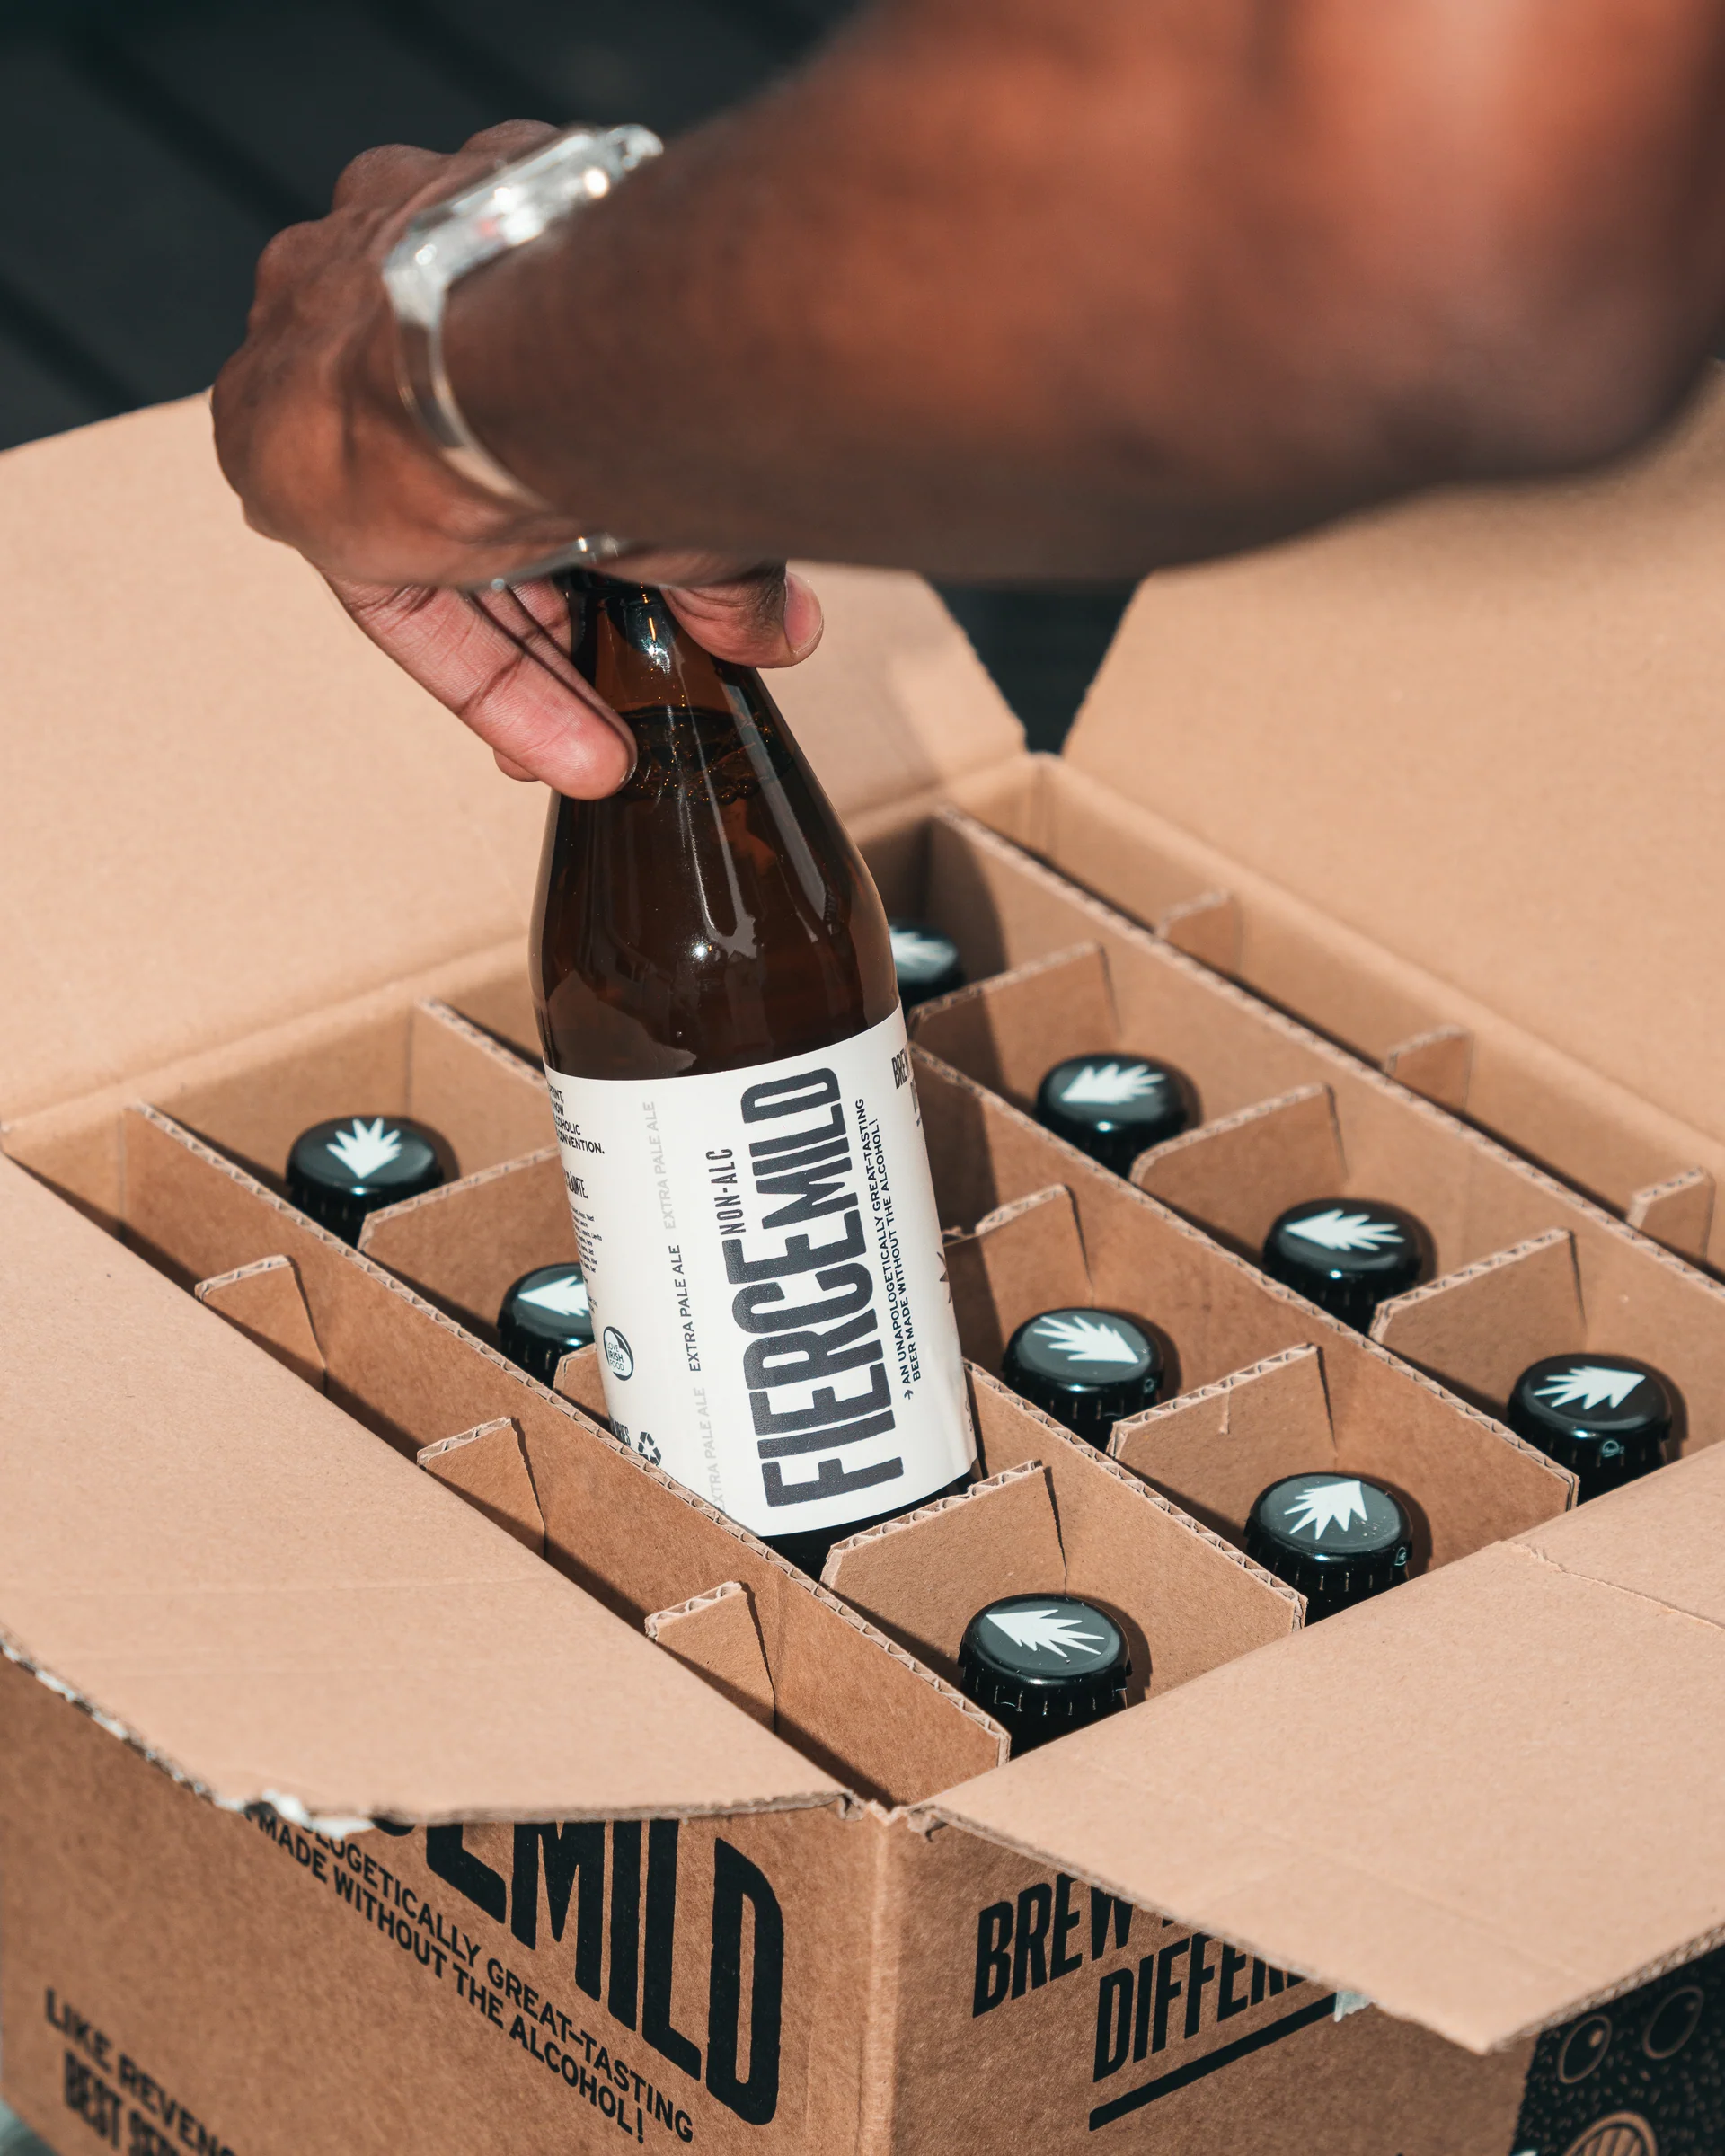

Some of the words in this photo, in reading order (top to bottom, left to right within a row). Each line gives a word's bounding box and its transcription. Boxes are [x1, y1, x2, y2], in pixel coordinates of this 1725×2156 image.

[891, 1047, 910, 1089] BRE
[642, 1101, 659, 1132] ALE
[649, 1135, 666, 1175] PALE
[855, 1099, 881, 1211] GREAT-TASTING
[869, 1118, 889, 1191] ALCOHOL!
[657, 1179, 677, 1229] EXTRA
[706, 1149, 746, 1235] NON-ALC
[883, 1196, 895, 1226] THE
[668, 1245, 684, 1275] ALE
[889, 1230, 907, 1295] WITHOUT
[674, 1279, 692, 1317] PALE
[722, 1067, 904, 1508] FIERCEMILD
[874, 1216, 906, 1362] UNAPOLOGETICALLY
[900, 1297, 915, 1340] MADE
[606, 1341, 619, 1353] LOVE
[608, 1350, 624, 1363] IRISH
[609, 1359, 624, 1372] FOOD
[682, 1321, 701, 1371] EXTRA
[907, 1341, 921, 1382] BEER
[900, 1364, 912, 1384] AN
[693, 1387, 710, 1417] ALE
[700, 1421, 717, 1459] PALE
[258, 1813, 327, 1884] MADE
[333, 1864, 447, 1978] WITHOUT
[453, 1962, 504, 2029] THE
[509, 2014, 644, 2144] ALCOHOL!
[47, 1986, 112, 2073] LIKE
[119, 2052, 235, 2156] REVEN
[487, 1957, 693, 2143] GREAT-TASTING
